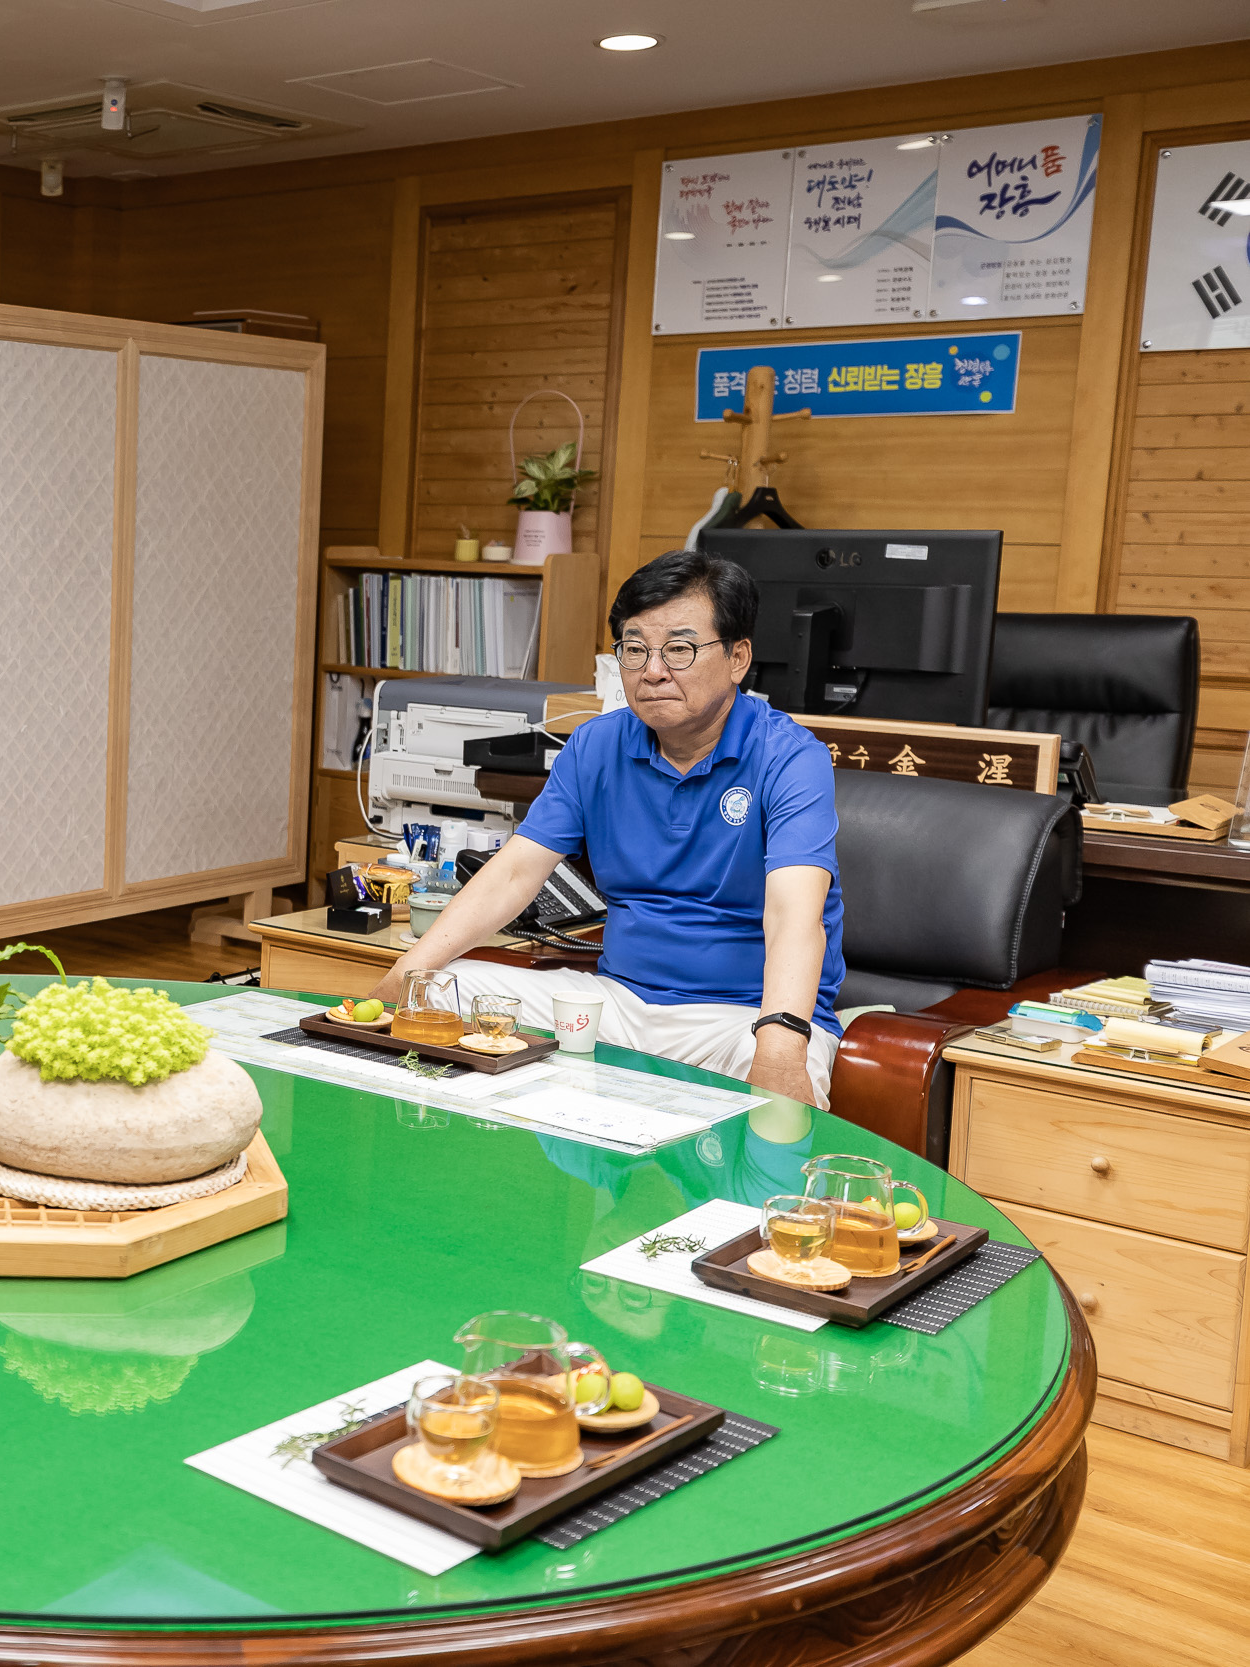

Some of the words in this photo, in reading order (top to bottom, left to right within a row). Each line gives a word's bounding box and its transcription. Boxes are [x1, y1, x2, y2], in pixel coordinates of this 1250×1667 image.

[967, 151, 1038, 188] 어머니
[1040, 145, 1067, 178] 품
[831, 192, 864, 211] 전남
[979, 175, 1062, 220] 장흥
[713, 371, 780, 397] 품격
[784, 367, 821, 395] 청렴,
[828, 364, 900, 393] 신뢰받는
[905, 361, 943, 390] 장흥
[839, 551, 862, 568] LG
[827, 742, 870, 769] 군수
